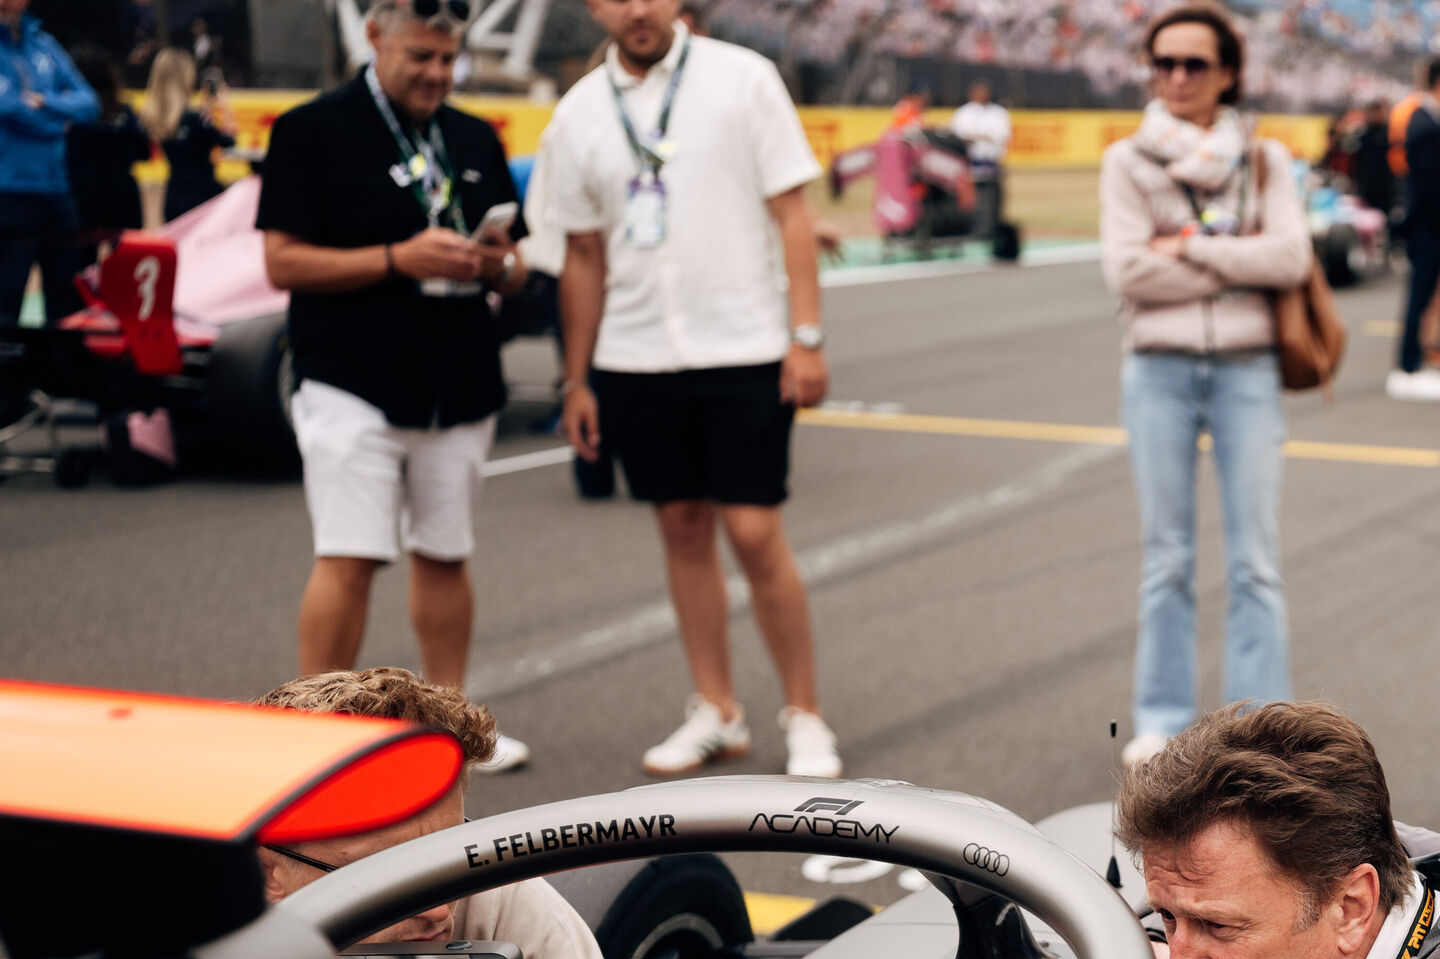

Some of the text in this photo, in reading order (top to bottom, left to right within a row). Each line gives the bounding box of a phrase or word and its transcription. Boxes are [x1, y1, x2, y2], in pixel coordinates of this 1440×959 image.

[133, 255, 161, 322] 3
[464, 813, 678, 870] E. FELBERMAYR
[748, 812, 900, 844] ACADEMY
[1407, 923, 1427, 950] PIT
